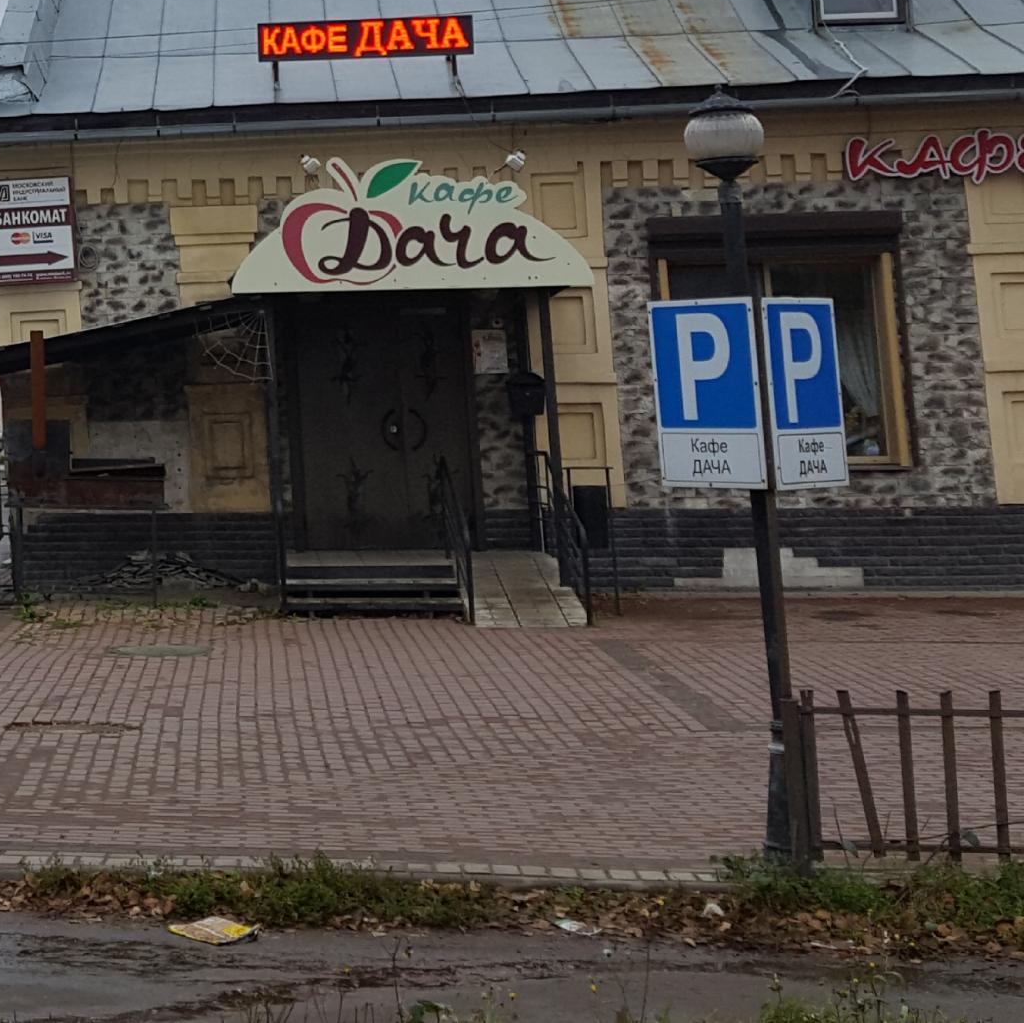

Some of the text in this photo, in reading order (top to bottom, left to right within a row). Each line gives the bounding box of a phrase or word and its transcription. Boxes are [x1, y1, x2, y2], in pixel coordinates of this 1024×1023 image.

[262, 17, 470, 57] КАФЕ ДАЧА
[846, 129, 1024, 184] КАФ
[12, 181, 53, 189] МОСКОВСКИЙ
[12, 187, 66, 196] ИНДУСТРИАЛЬНЫЙ
[318, 207, 557, 276] Дача
[676, 312, 730, 421] P
[779, 311, 822, 424] P
[691, 437, 728, 456] Кафе
[798, 438, 825, 456] Кафе
[692, 459, 732, 477] ДАЧА
[799, 459, 828, 477] ДАЧА
